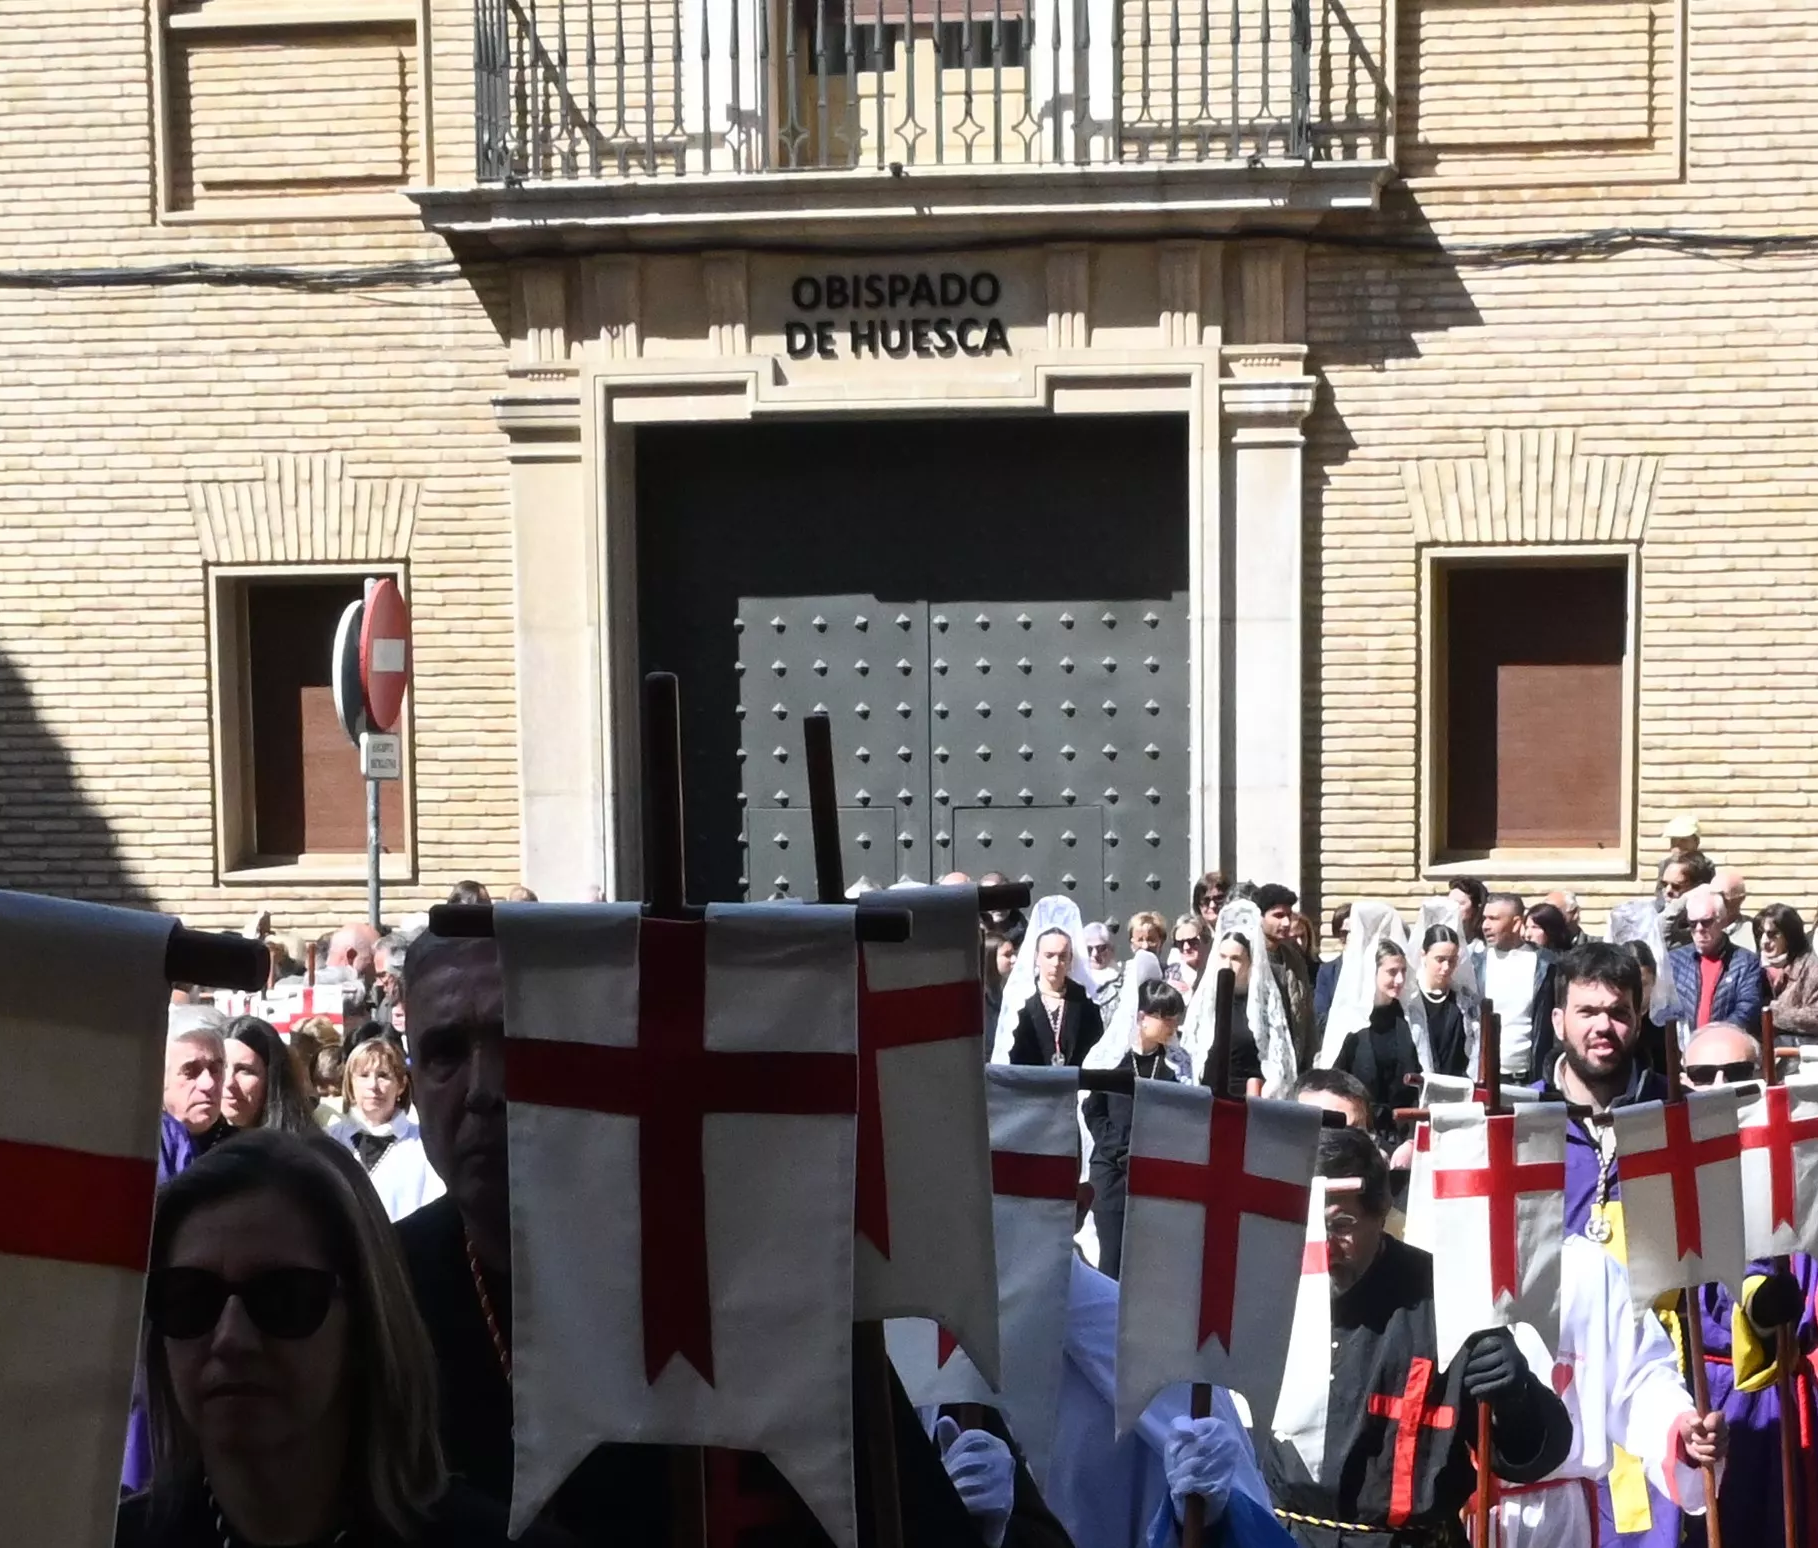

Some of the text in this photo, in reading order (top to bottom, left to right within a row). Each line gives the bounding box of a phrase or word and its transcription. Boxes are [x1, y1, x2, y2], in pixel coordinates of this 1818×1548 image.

[791, 271, 1001, 311] OBISPADO
[784, 317, 1012, 359] DE HUESCA
